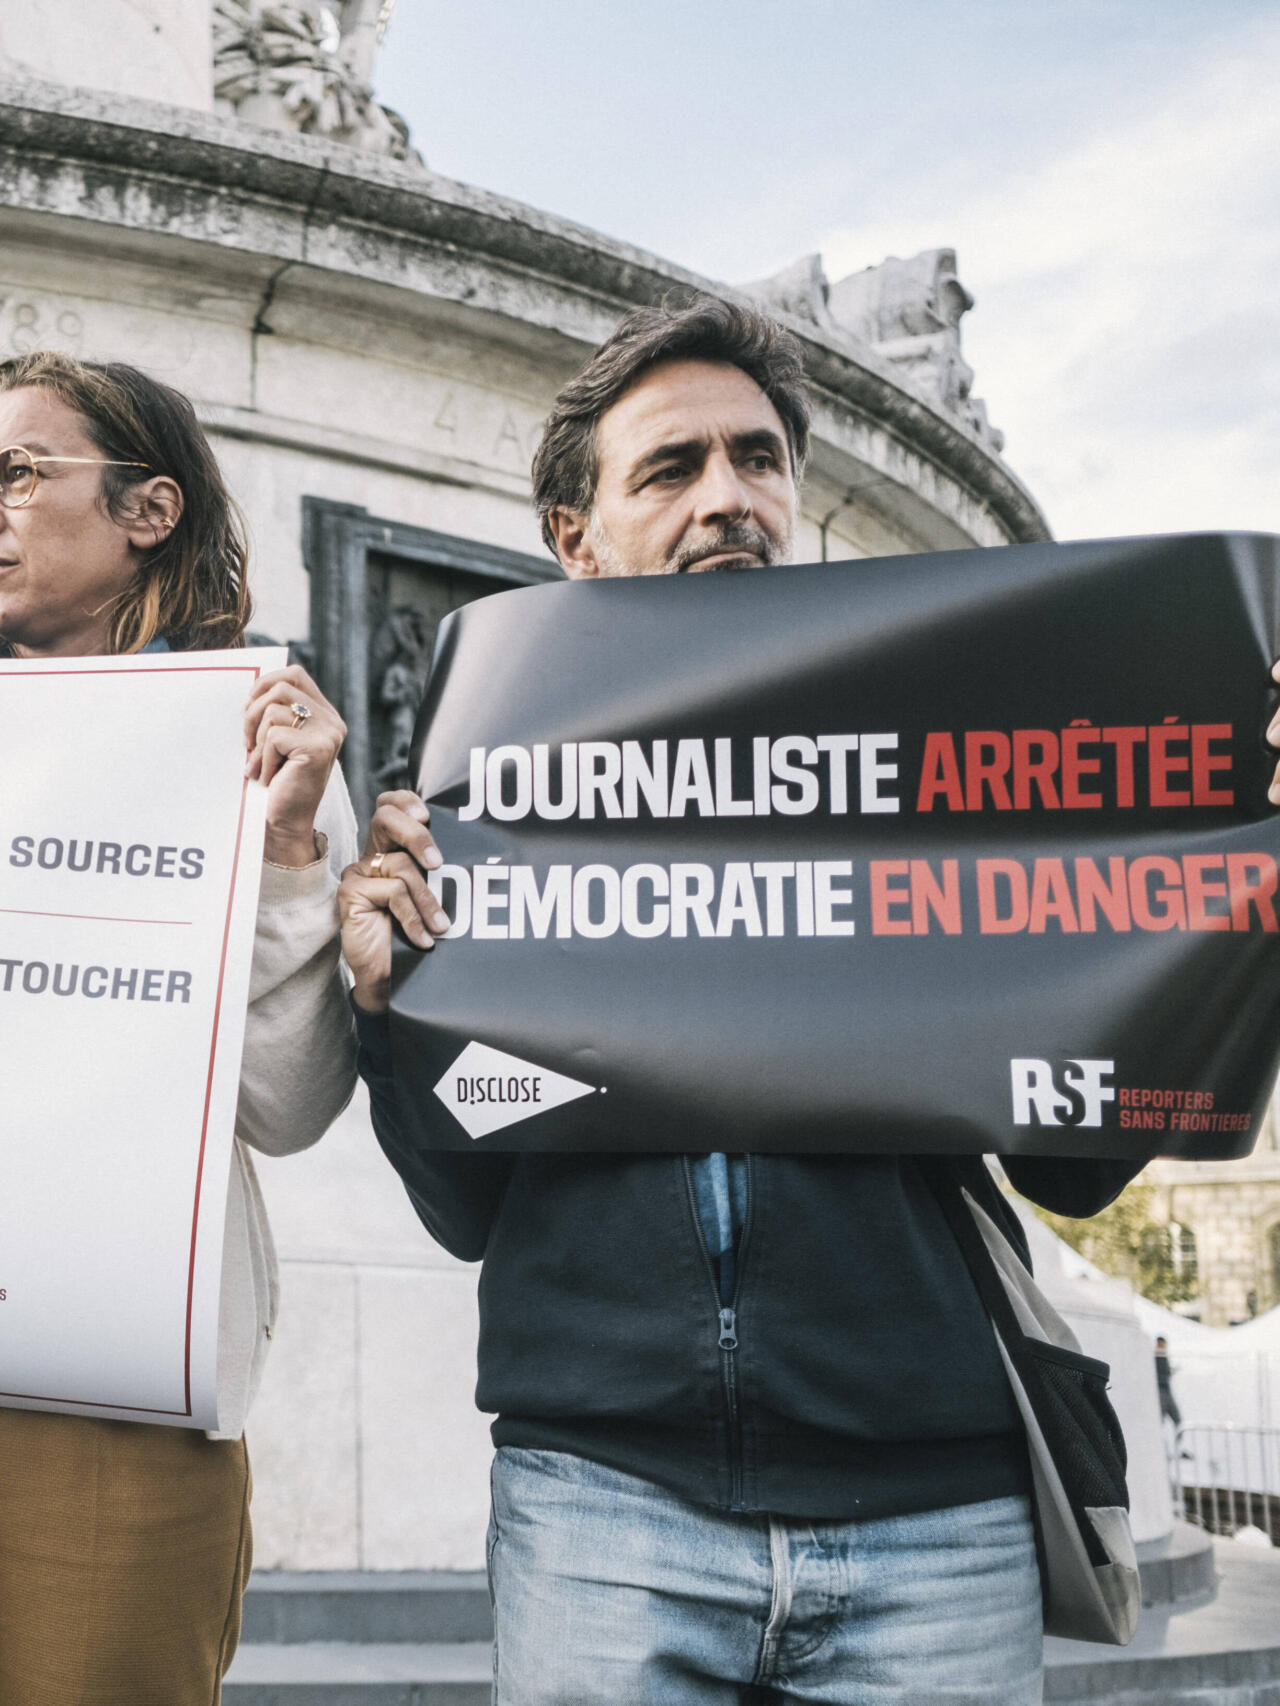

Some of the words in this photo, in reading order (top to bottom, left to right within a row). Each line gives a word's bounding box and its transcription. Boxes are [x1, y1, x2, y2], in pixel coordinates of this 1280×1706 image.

[458, 733, 900, 822] JOURNALISTE
[916, 716, 1235, 813] ARRÊTÉE
[8, 836, 206, 880] SOURCES
[427, 856, 856, 940] DÉMOCRATIE
[869, 859, 962, 936] EN
[976, 852, 1280, 934] DANGER
[1010, 1058, 1115, 1127] RSF
[1119, 1088, 1214, 1111] REPORTERS
[1119, 1110, 1165, 1130] SANS
[1170, 1112, 1252, 1132] FRONTIERES
